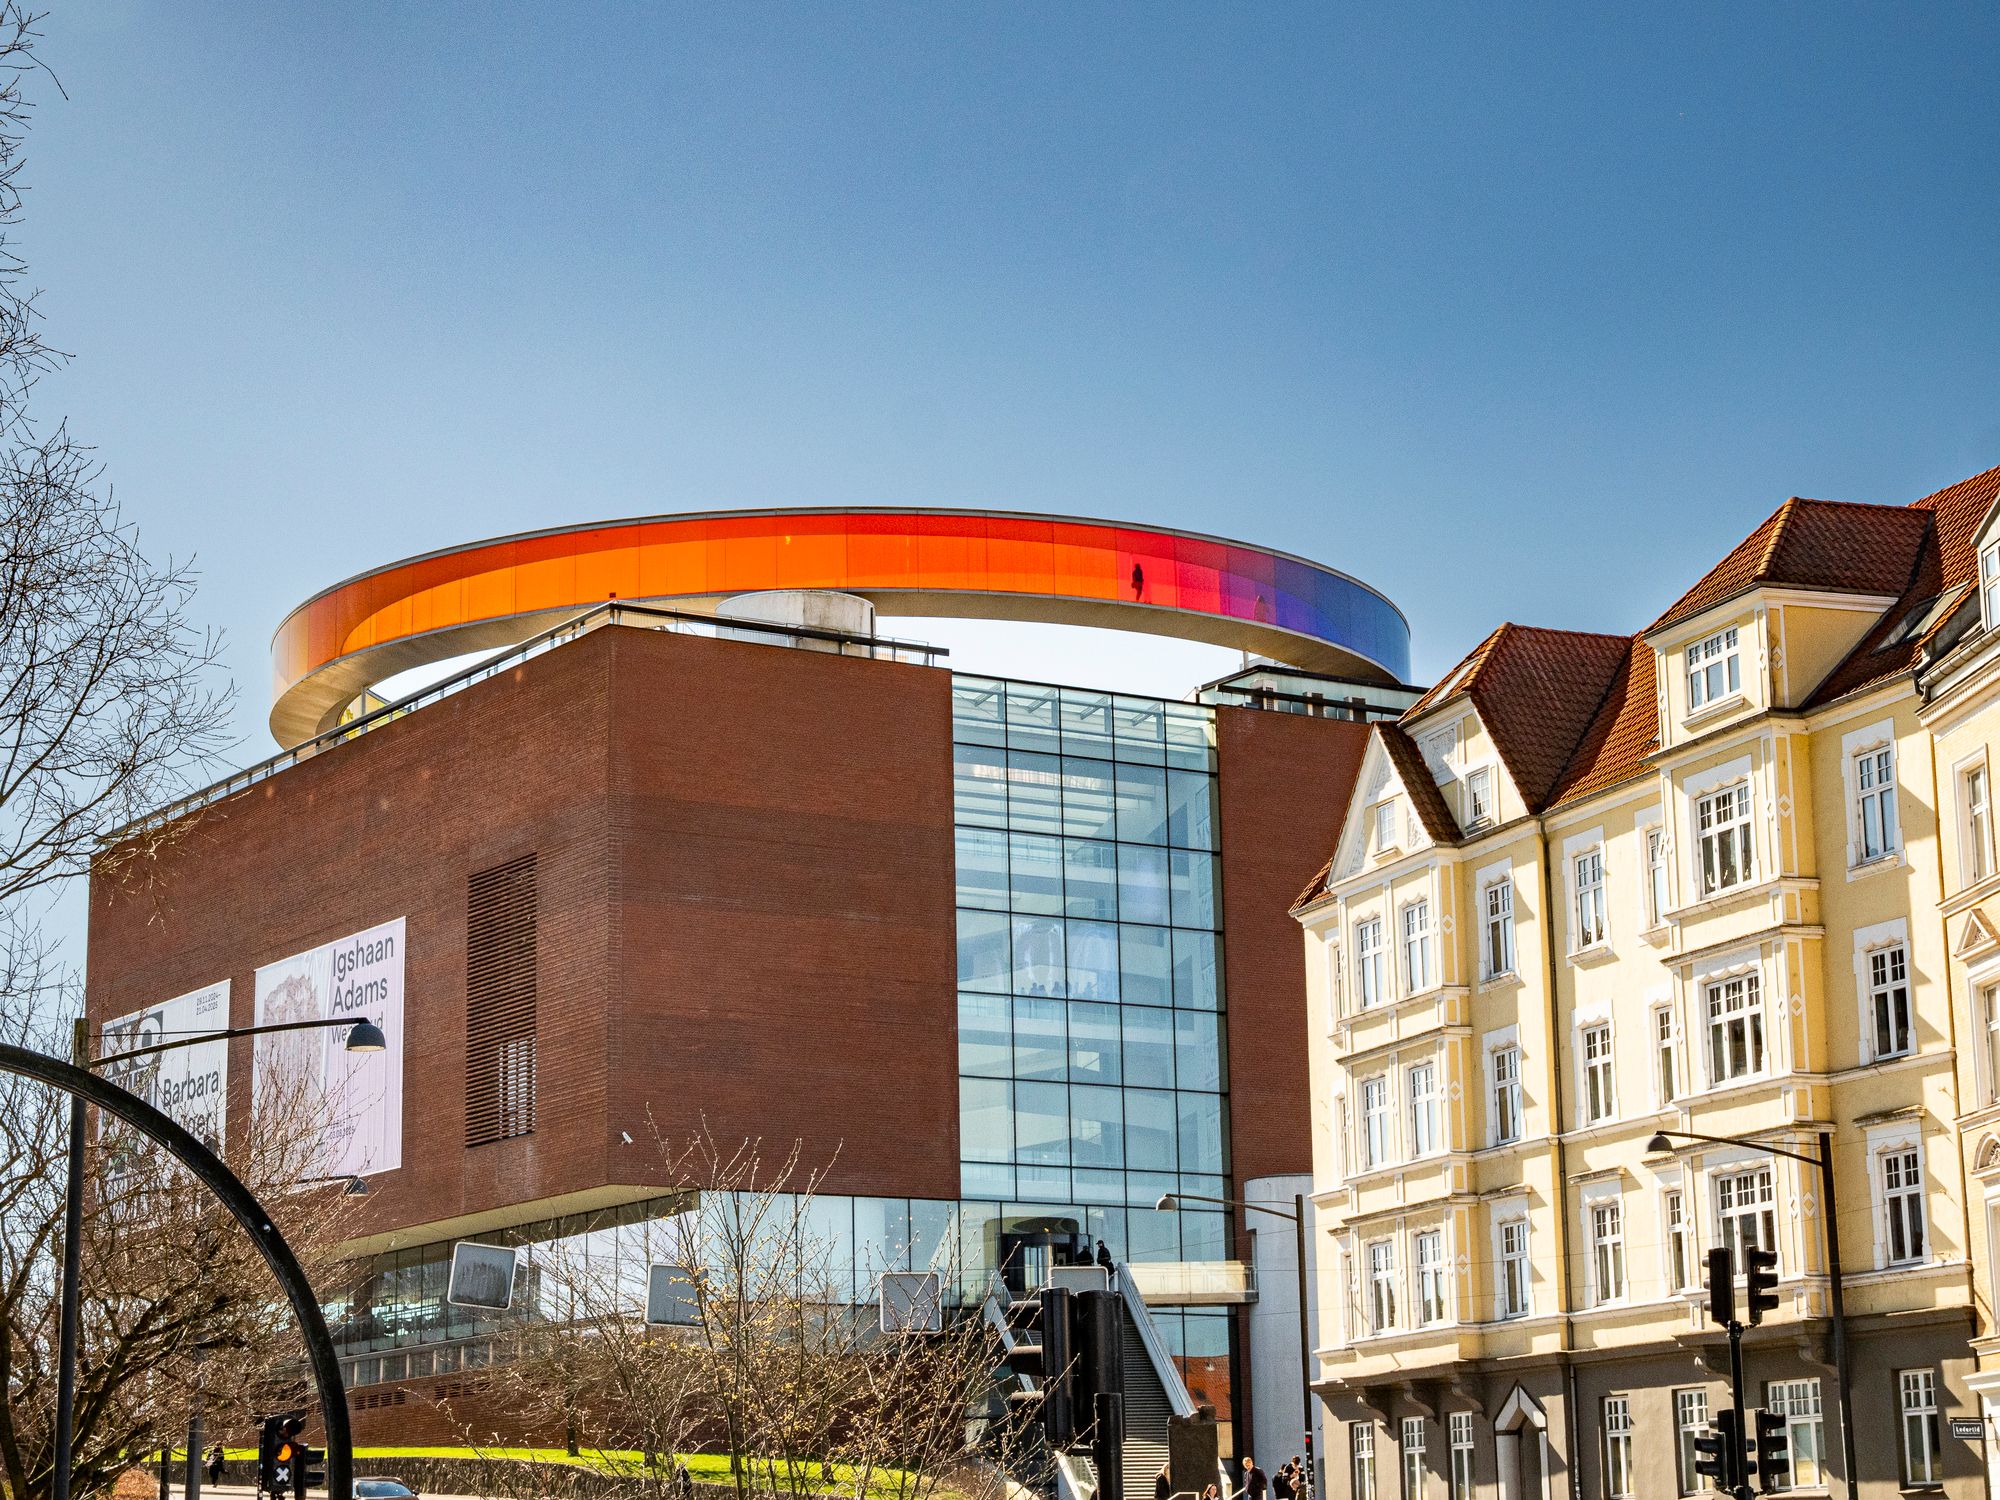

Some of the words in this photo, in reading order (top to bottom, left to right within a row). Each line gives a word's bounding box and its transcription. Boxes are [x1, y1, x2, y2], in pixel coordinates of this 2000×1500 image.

[333, 936, 394, 982] Igshaan
[331, 977, 388, 1015] Adams
[163, 1070, 219, 1107] Barbara
